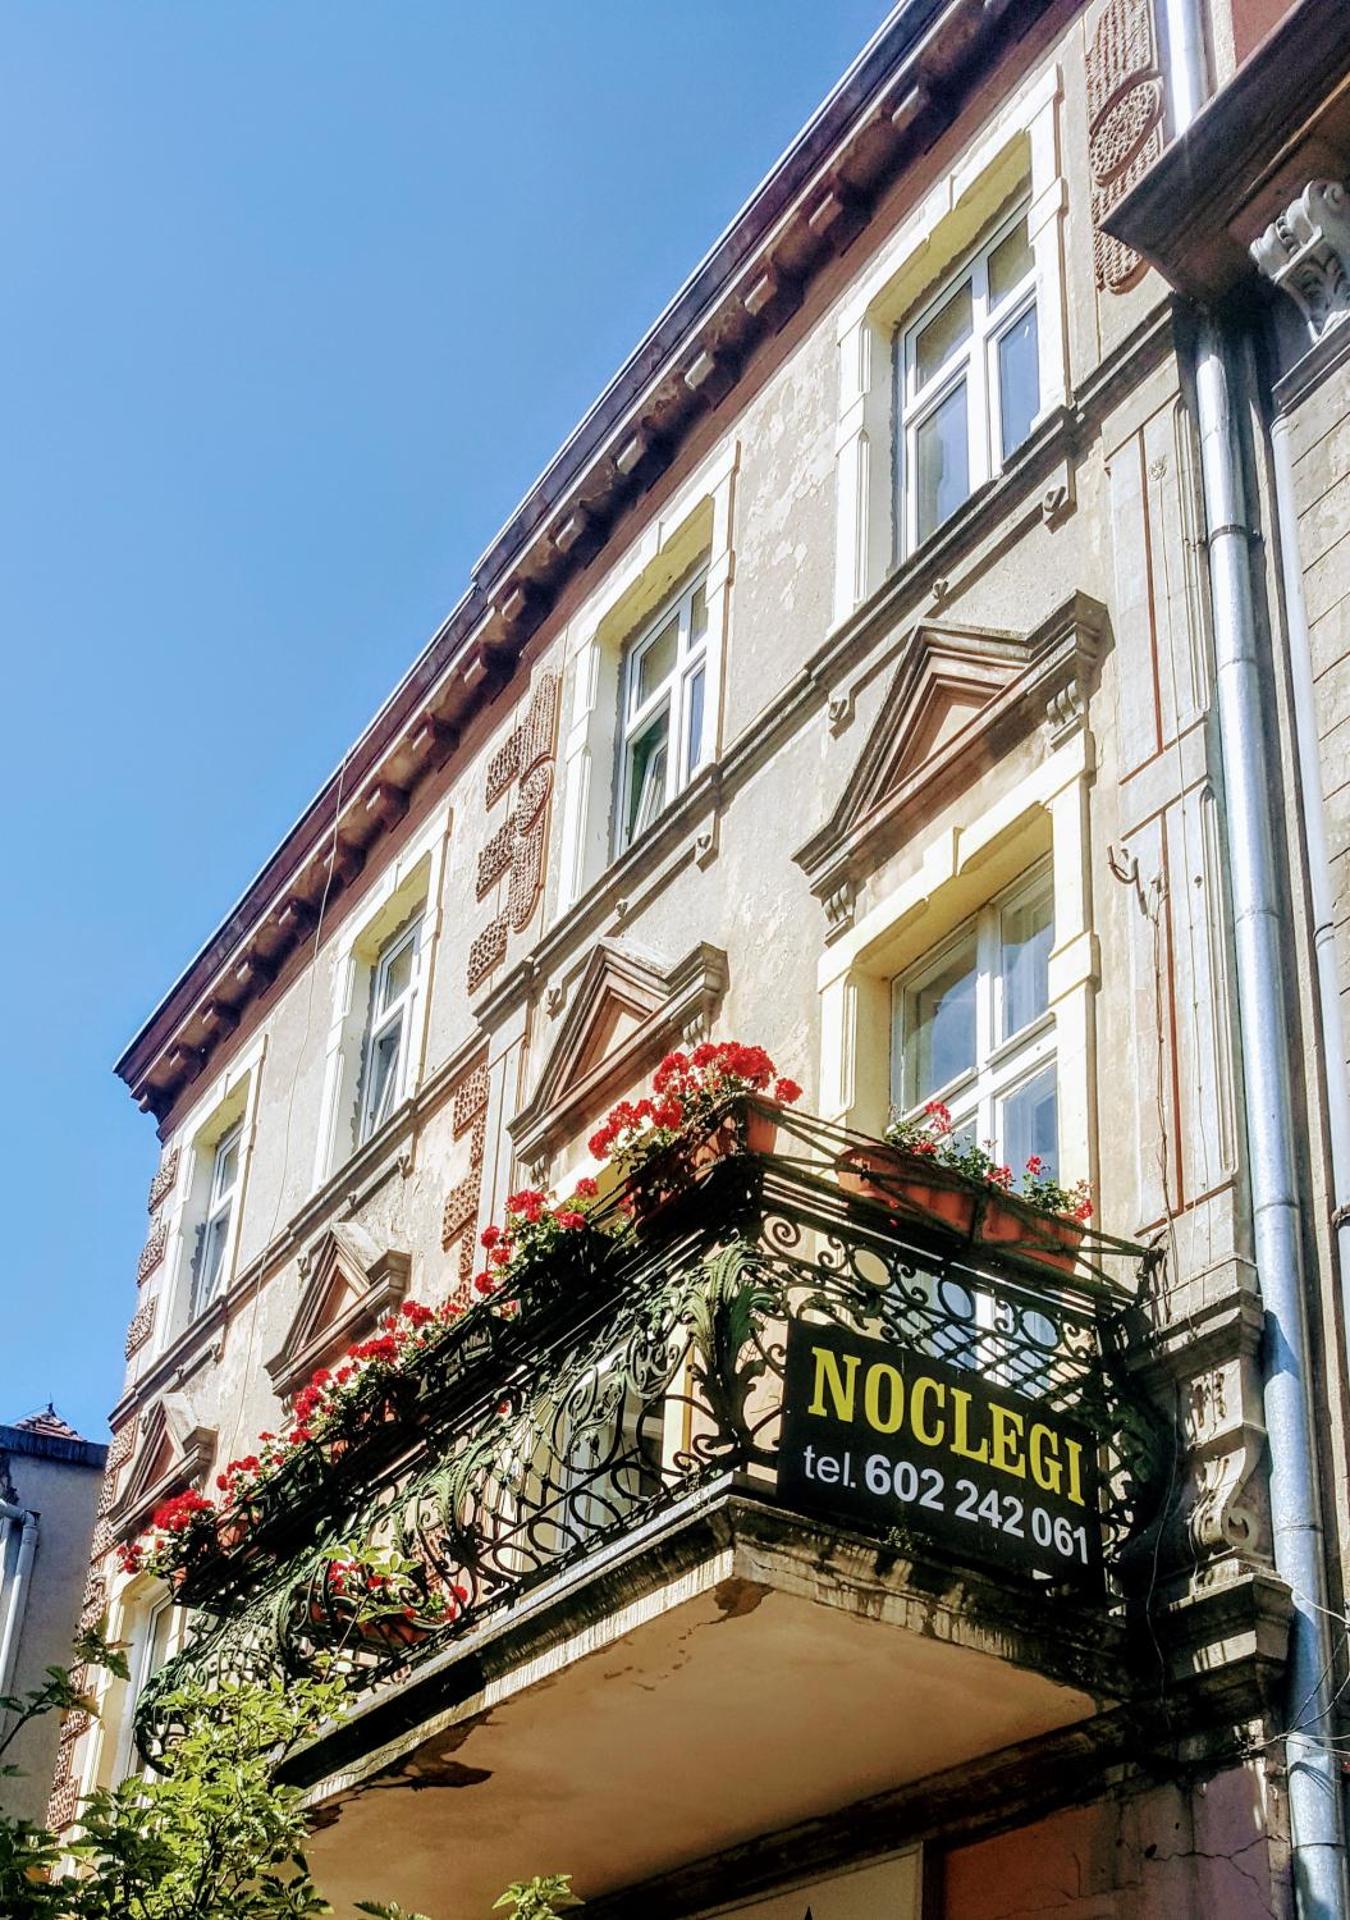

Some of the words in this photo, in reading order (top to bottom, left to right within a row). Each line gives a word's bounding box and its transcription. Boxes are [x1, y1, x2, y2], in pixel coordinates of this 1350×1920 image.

[808, 1347, 1085, 1506] NOCLEGI
[803, 1445, 857, 1488] tel.
[865, 1454, 944, 1511] 602
[955, 1479, 1025, 1538] 242
[1031, 1508, 1088, 1565] 061
